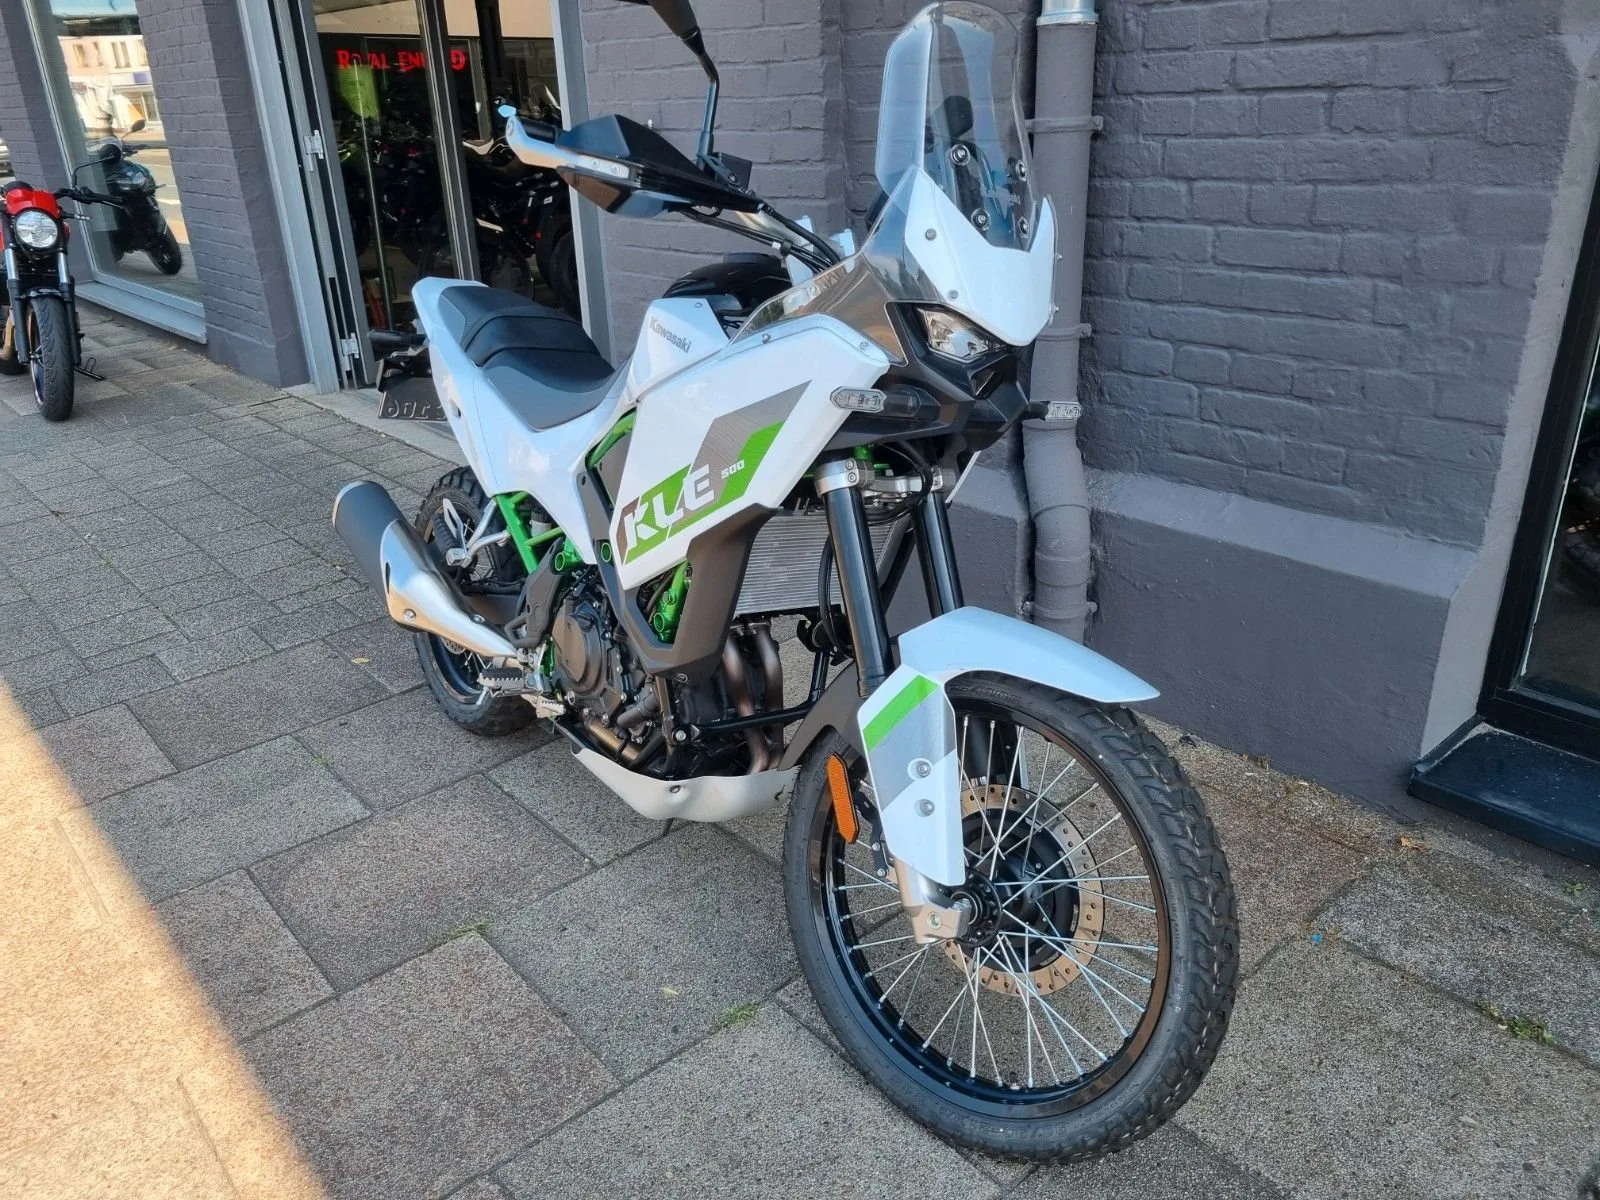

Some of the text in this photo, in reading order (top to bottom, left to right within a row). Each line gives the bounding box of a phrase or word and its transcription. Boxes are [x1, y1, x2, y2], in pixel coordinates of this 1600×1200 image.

[649, 316, 692, 354] Kawasaki
[623, 459, 745, 551] KLE 500
